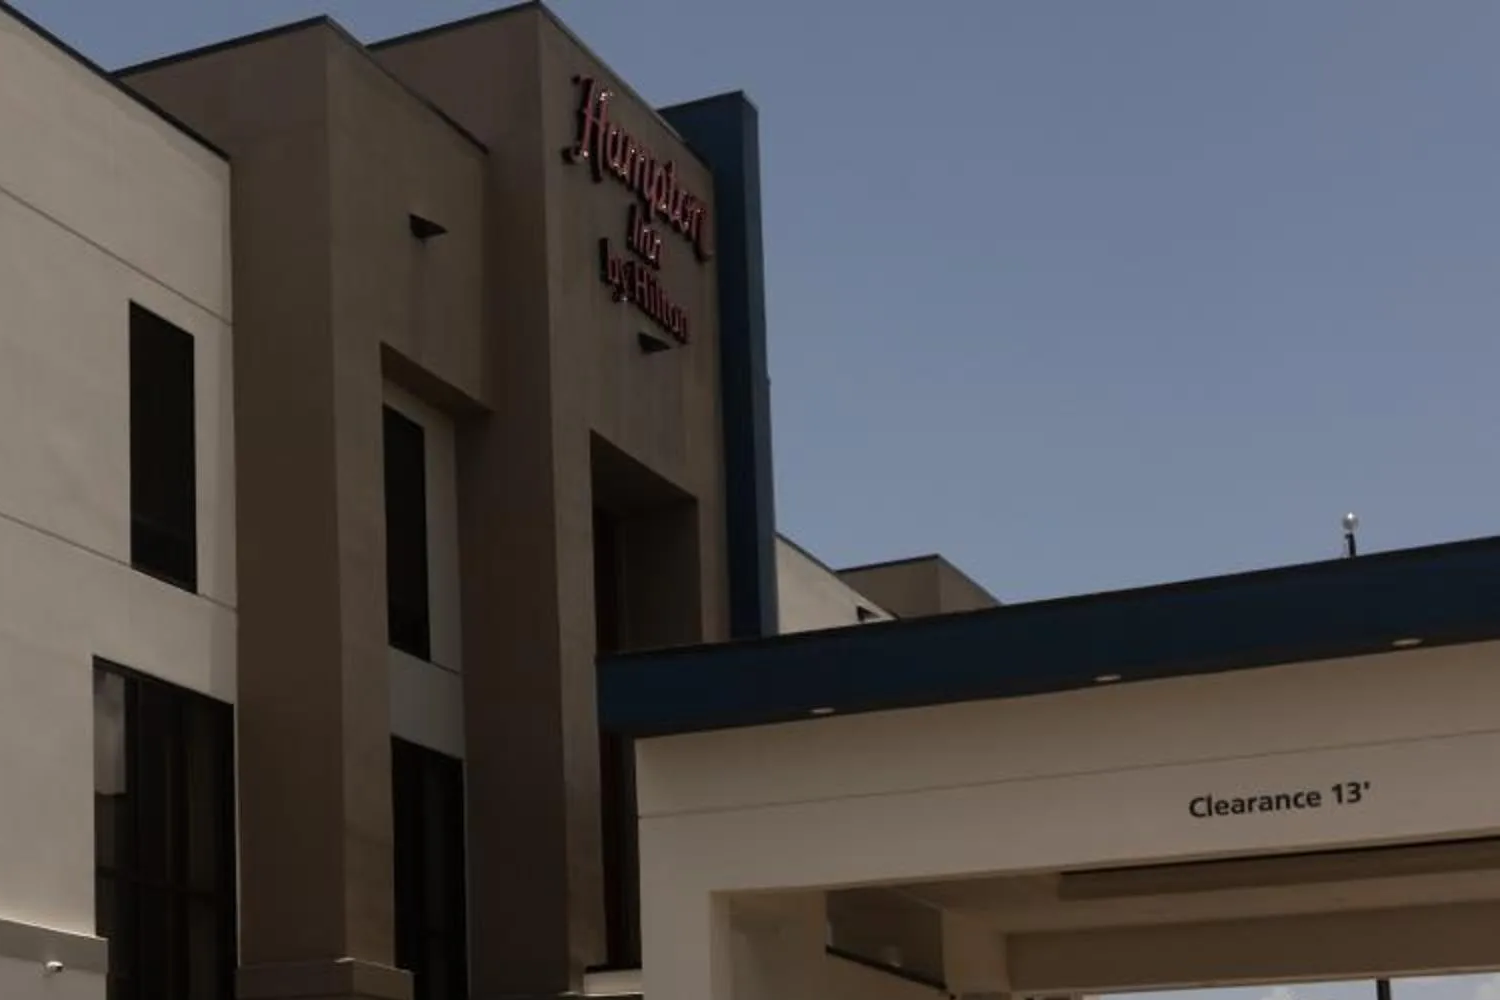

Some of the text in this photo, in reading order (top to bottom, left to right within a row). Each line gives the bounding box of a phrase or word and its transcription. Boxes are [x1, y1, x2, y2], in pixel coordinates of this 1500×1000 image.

[562, 75, 713, 262] Hampton
[1188, 781, 1371, 818] Clearance 13'
